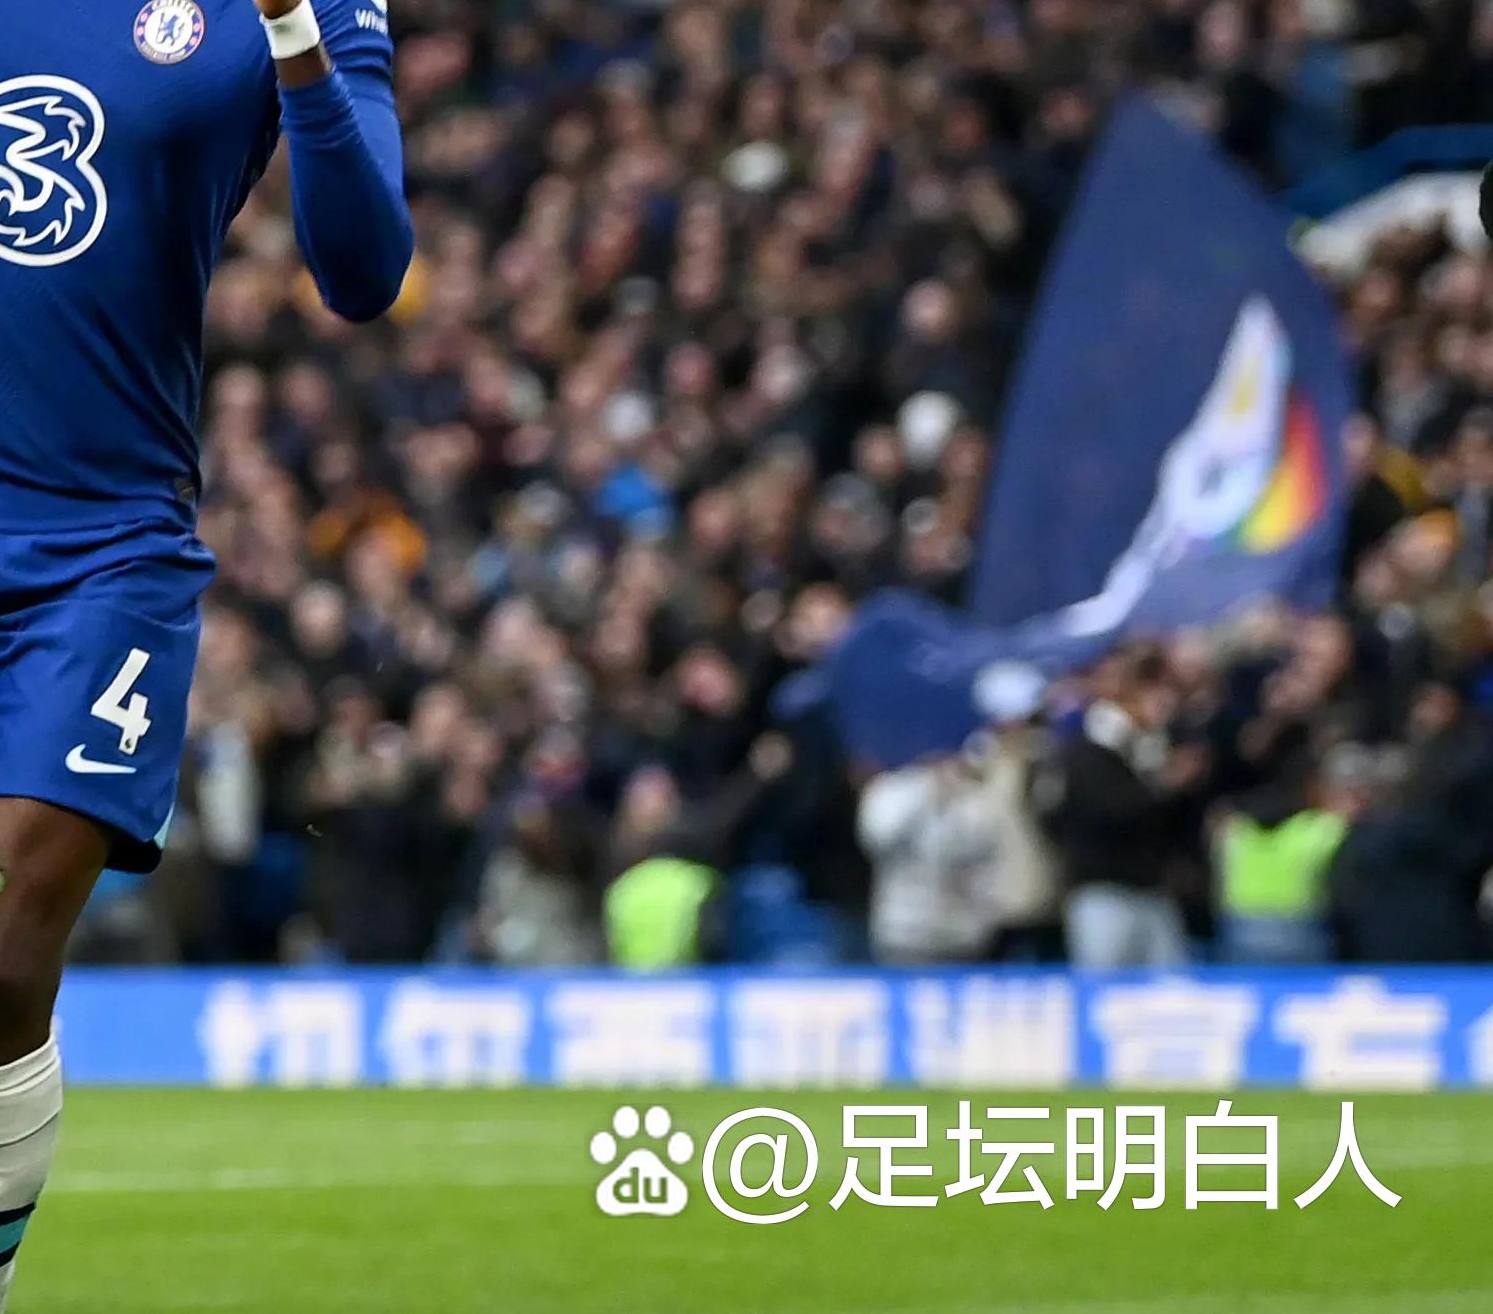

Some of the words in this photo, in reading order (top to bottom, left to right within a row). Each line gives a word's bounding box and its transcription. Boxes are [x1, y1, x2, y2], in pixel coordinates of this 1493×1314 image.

[90, 647, 153, 755] 4
[201, 974, 1493, 1092] 切尔西亚洲官方
